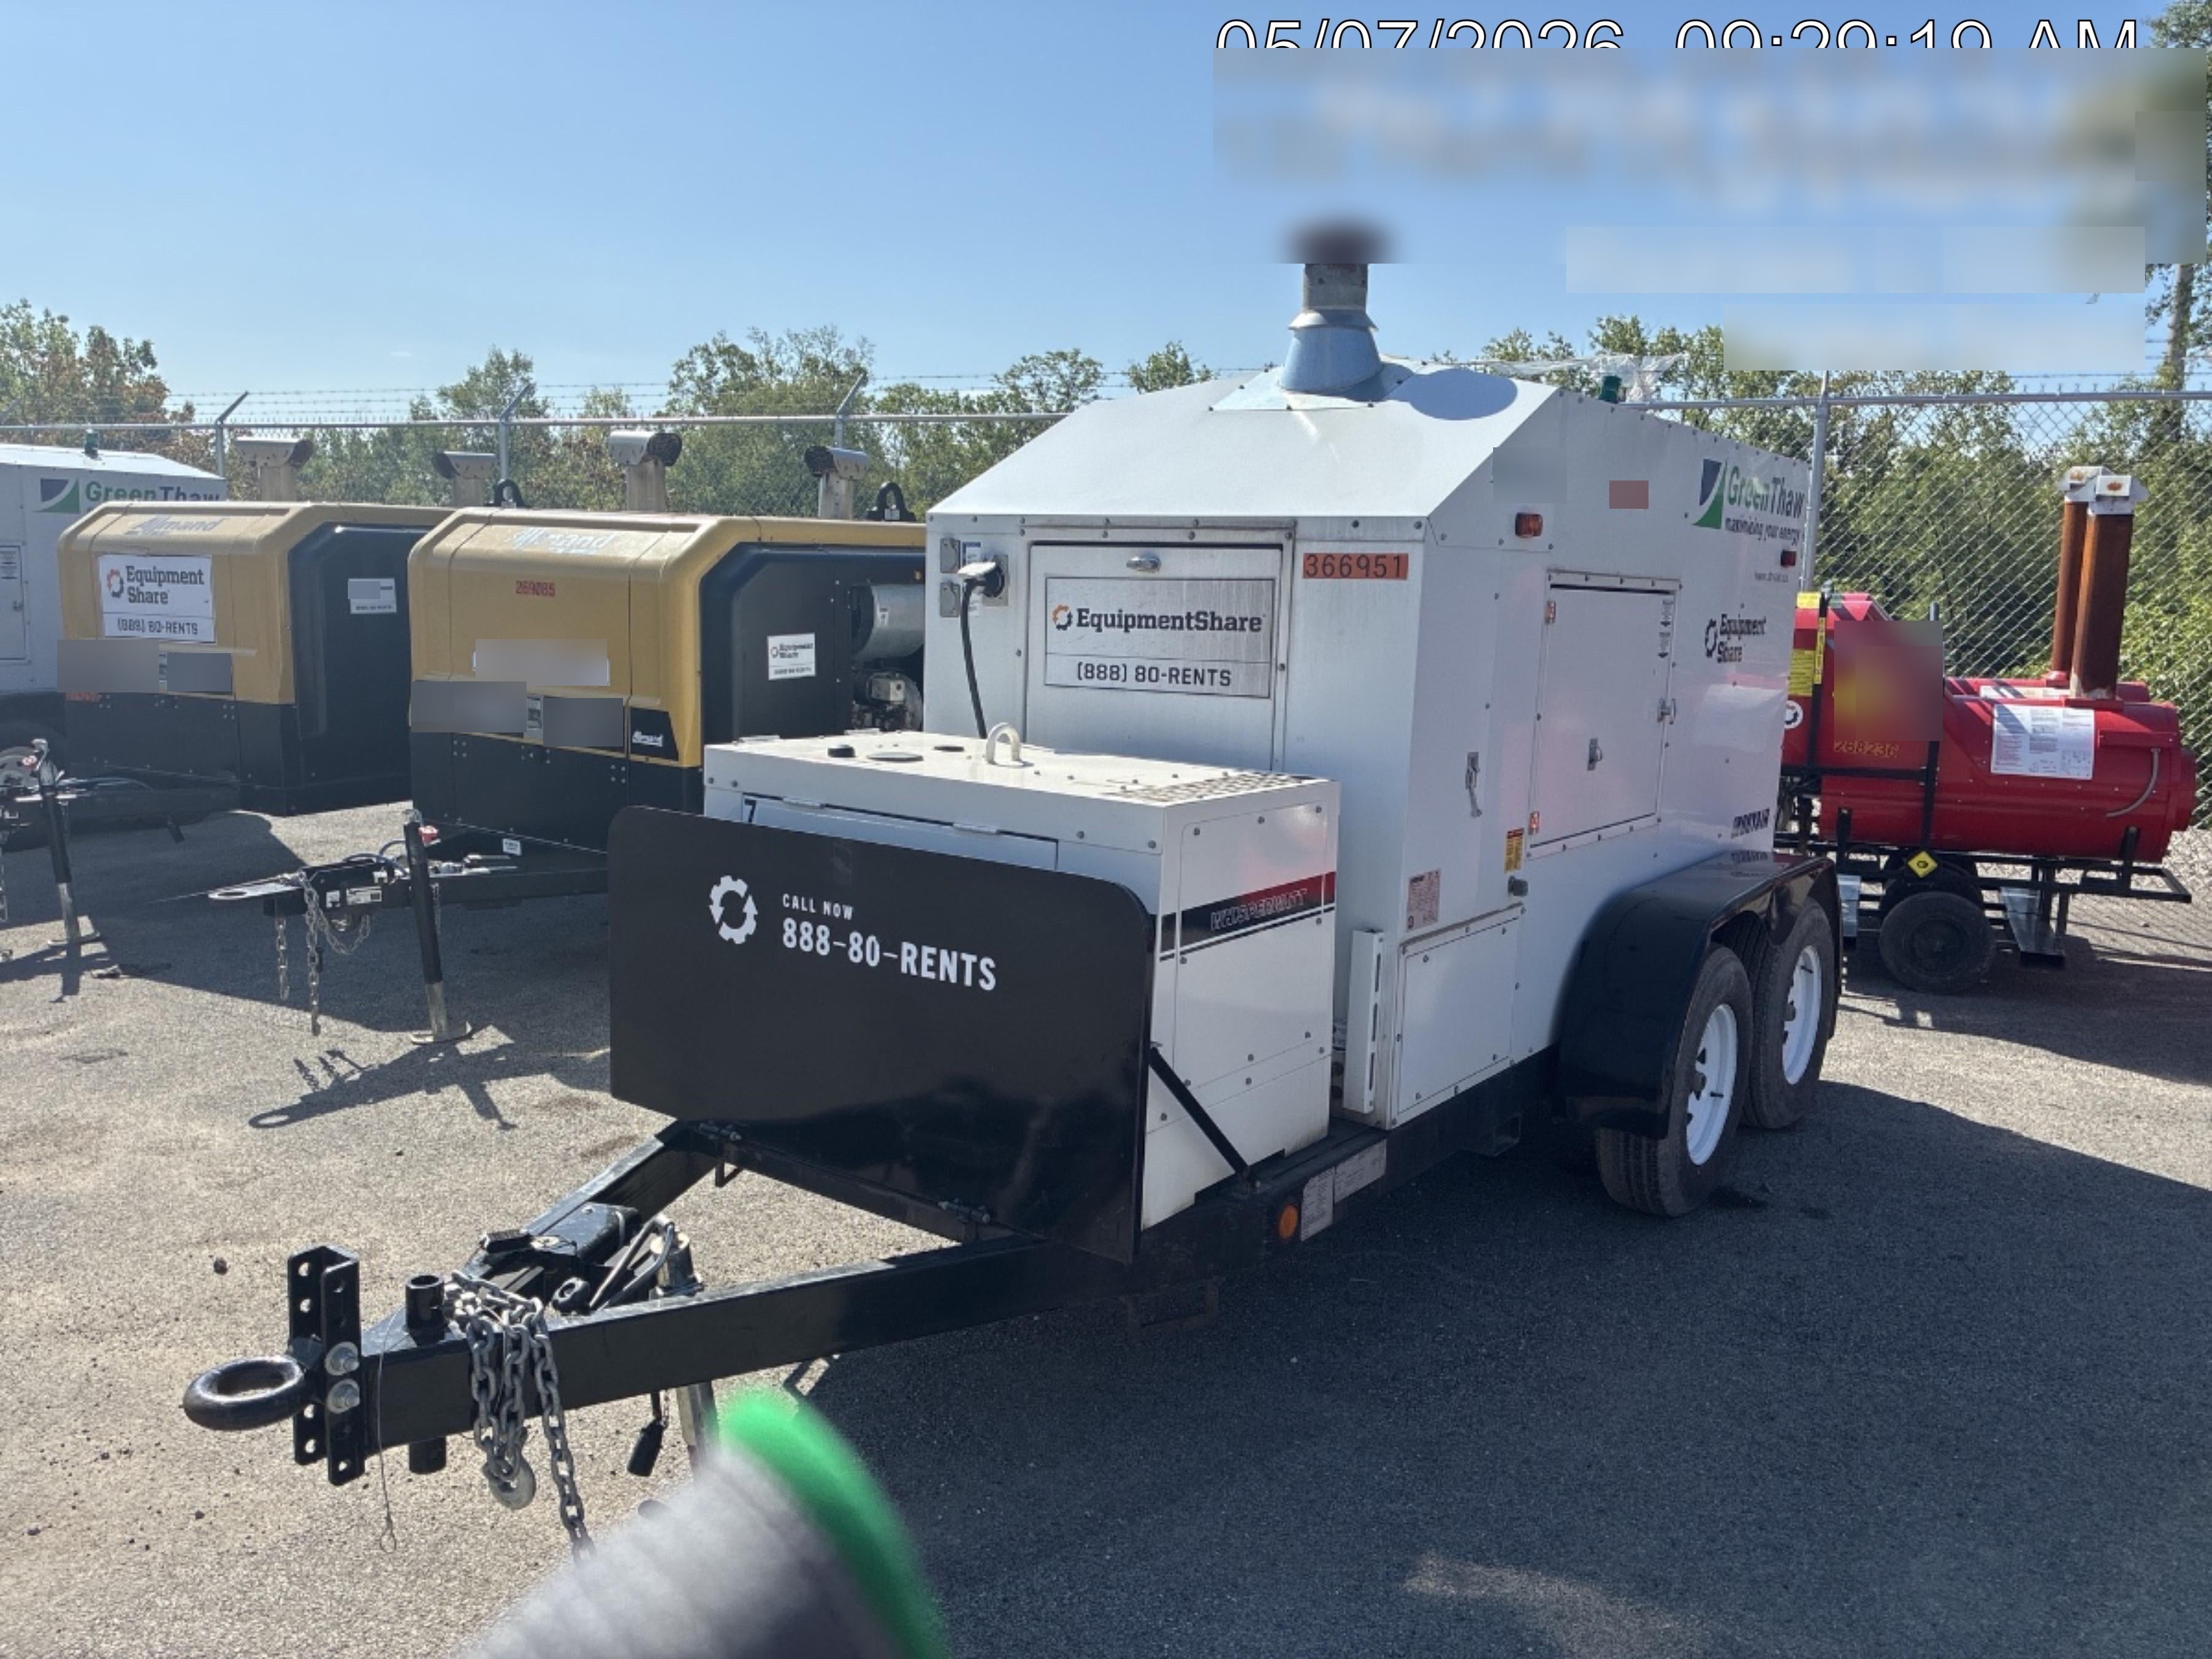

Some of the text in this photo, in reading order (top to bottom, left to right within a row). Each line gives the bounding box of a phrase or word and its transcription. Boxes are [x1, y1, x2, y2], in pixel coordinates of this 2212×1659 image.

[1728, 466, 1805, 519] GreenThaw
[125, 566, 205, 587] Equipment
[1304, 554, 1402, 578] 366951
[127, 586, 169, 605] Share
[148, 621, 198, 635] 80-RENTS
[1077, 608, 1262, 632] EquipmentShare
[1720, 614, 1767, 640] Equipment
[1717, 641, 1743, 664] Share
[1077, 661, 1231, 686] (888) 80-RENTS
[782, 893, 854, 921] CALL NOW
[782, 917, 997, 991] 888-80-RENTS
